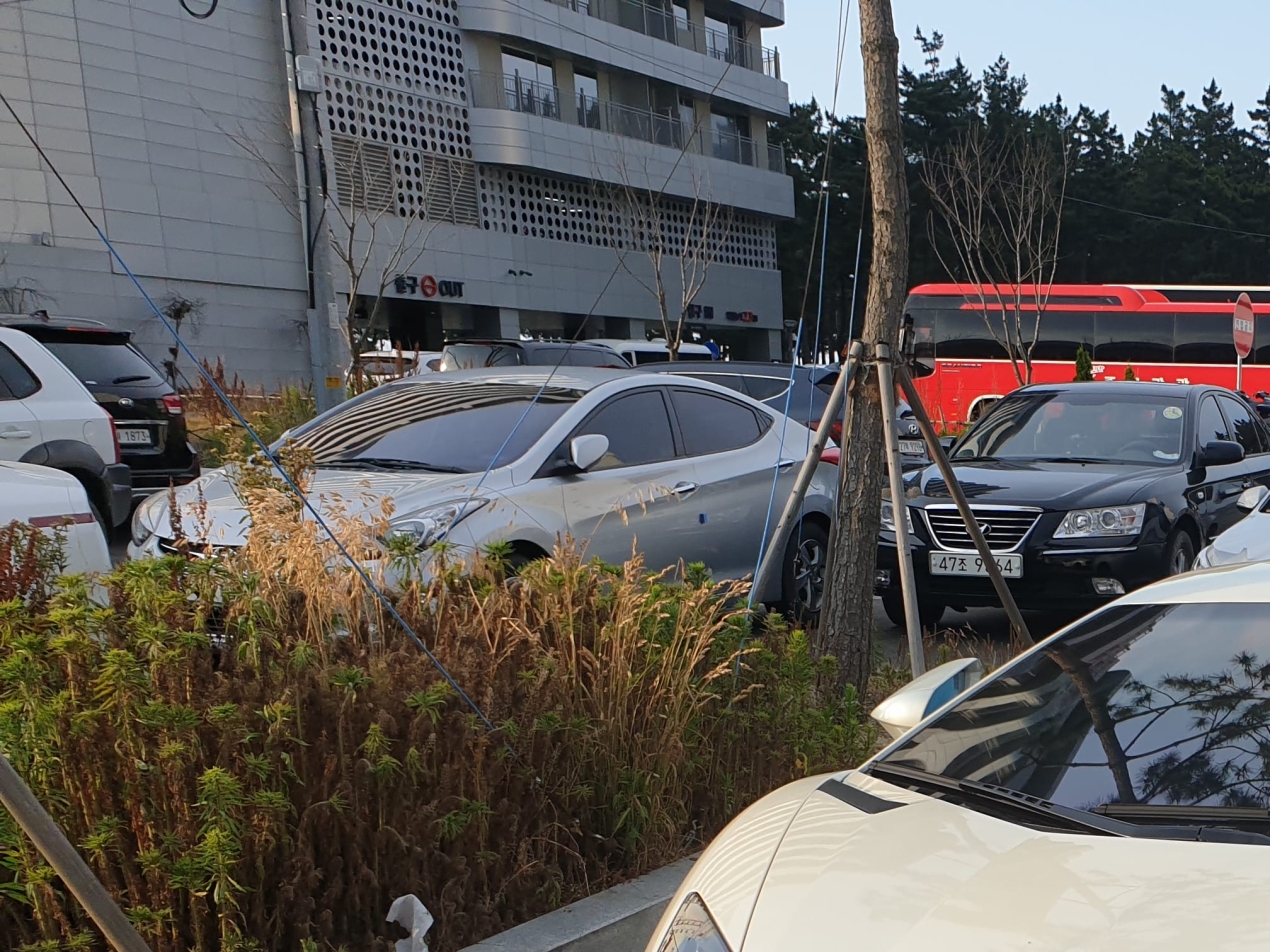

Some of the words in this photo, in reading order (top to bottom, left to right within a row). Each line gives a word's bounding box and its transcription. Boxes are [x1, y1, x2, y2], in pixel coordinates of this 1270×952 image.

[438, 280, 465, 298] OUT
[124, 430, 147, 442] 1873
[938, 556, 968, 573] 47조
[974, 557, 1014, 575] 964
